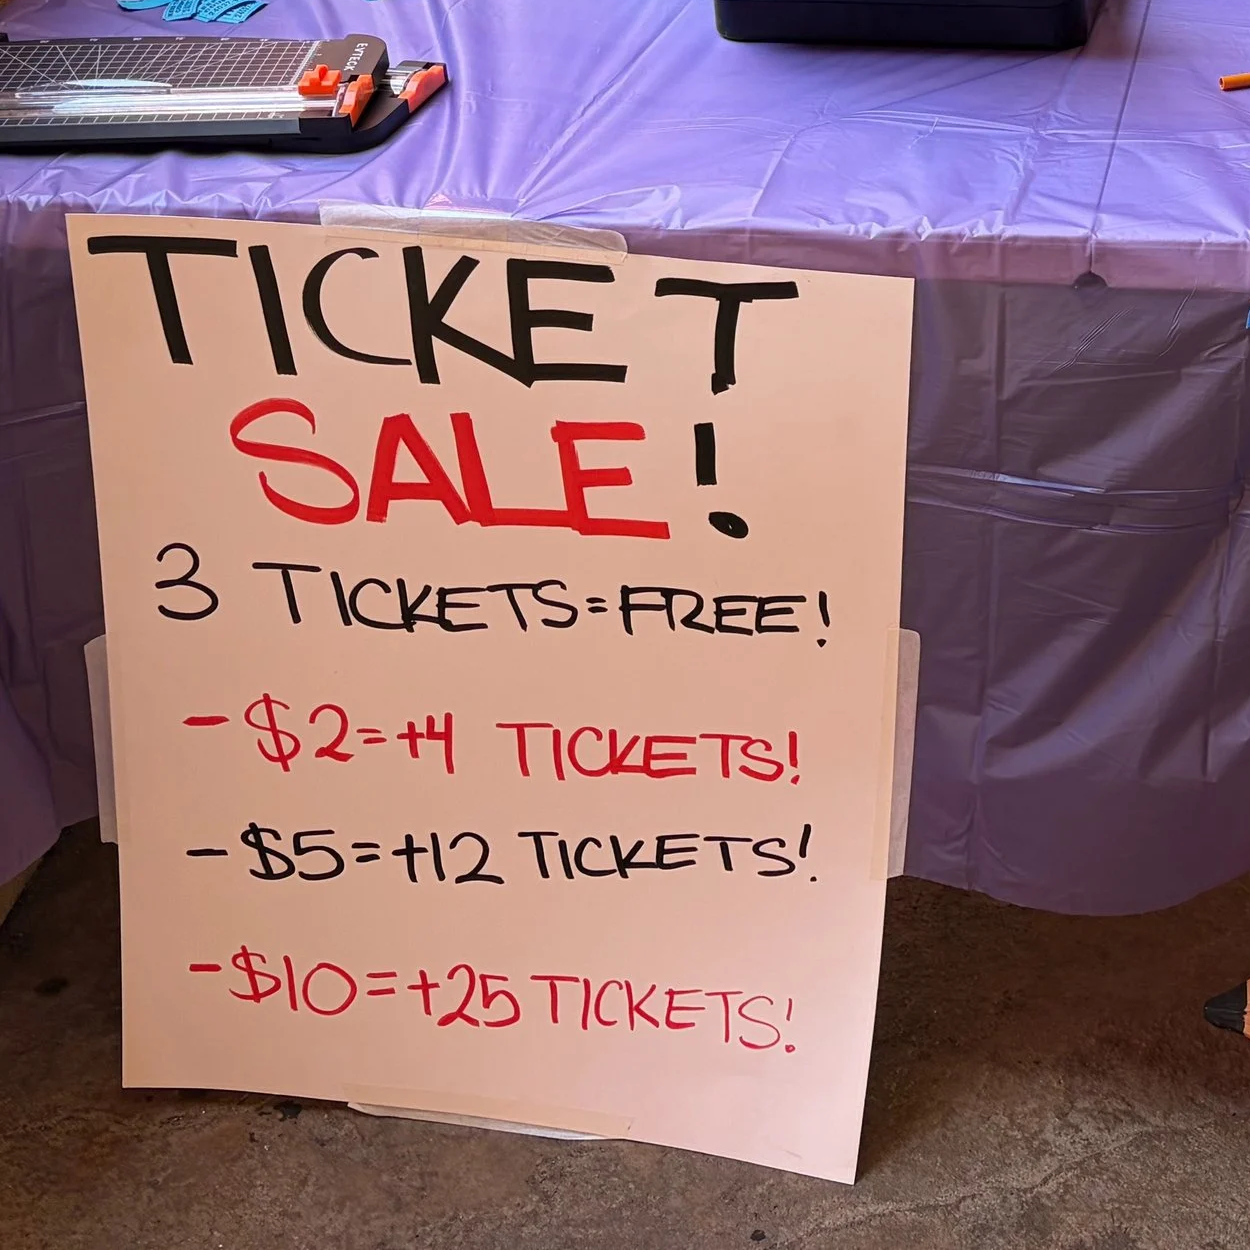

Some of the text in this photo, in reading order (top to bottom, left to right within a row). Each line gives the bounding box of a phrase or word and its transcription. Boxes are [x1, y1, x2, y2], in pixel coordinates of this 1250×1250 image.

[87, 235, 800, 396] TICKET
[155, 543, 218, 621] 3
[495, 721, 801, 785] TICKETS!
[517, 823, 815, 883] TICKETS!
[530, 973, 798, 1054] TICKETS!
